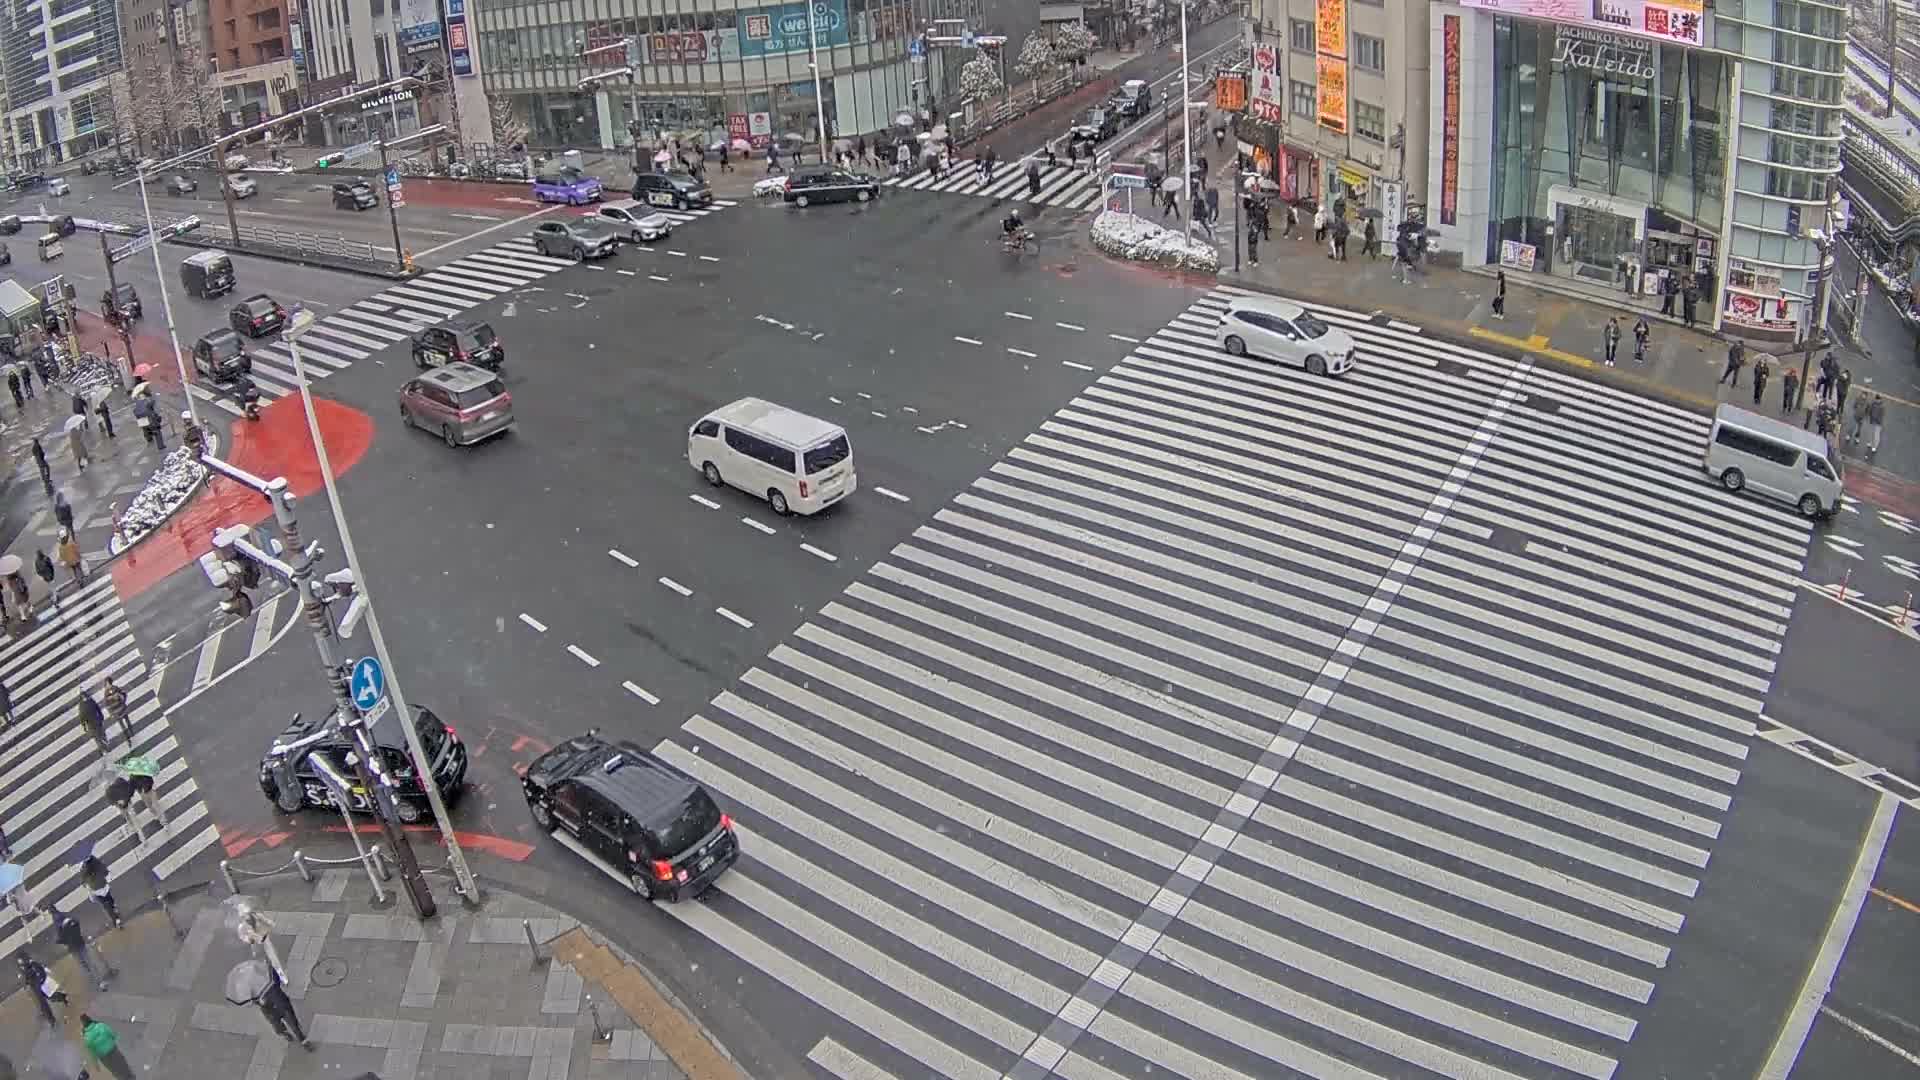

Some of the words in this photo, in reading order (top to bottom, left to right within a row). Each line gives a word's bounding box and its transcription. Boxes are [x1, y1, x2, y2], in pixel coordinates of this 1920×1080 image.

[1556, 24, 1611, 44] PACHINKO
[1624, 39, 1649, 51] SLOT
[1550, 38, 1655, 79] Kaleido
